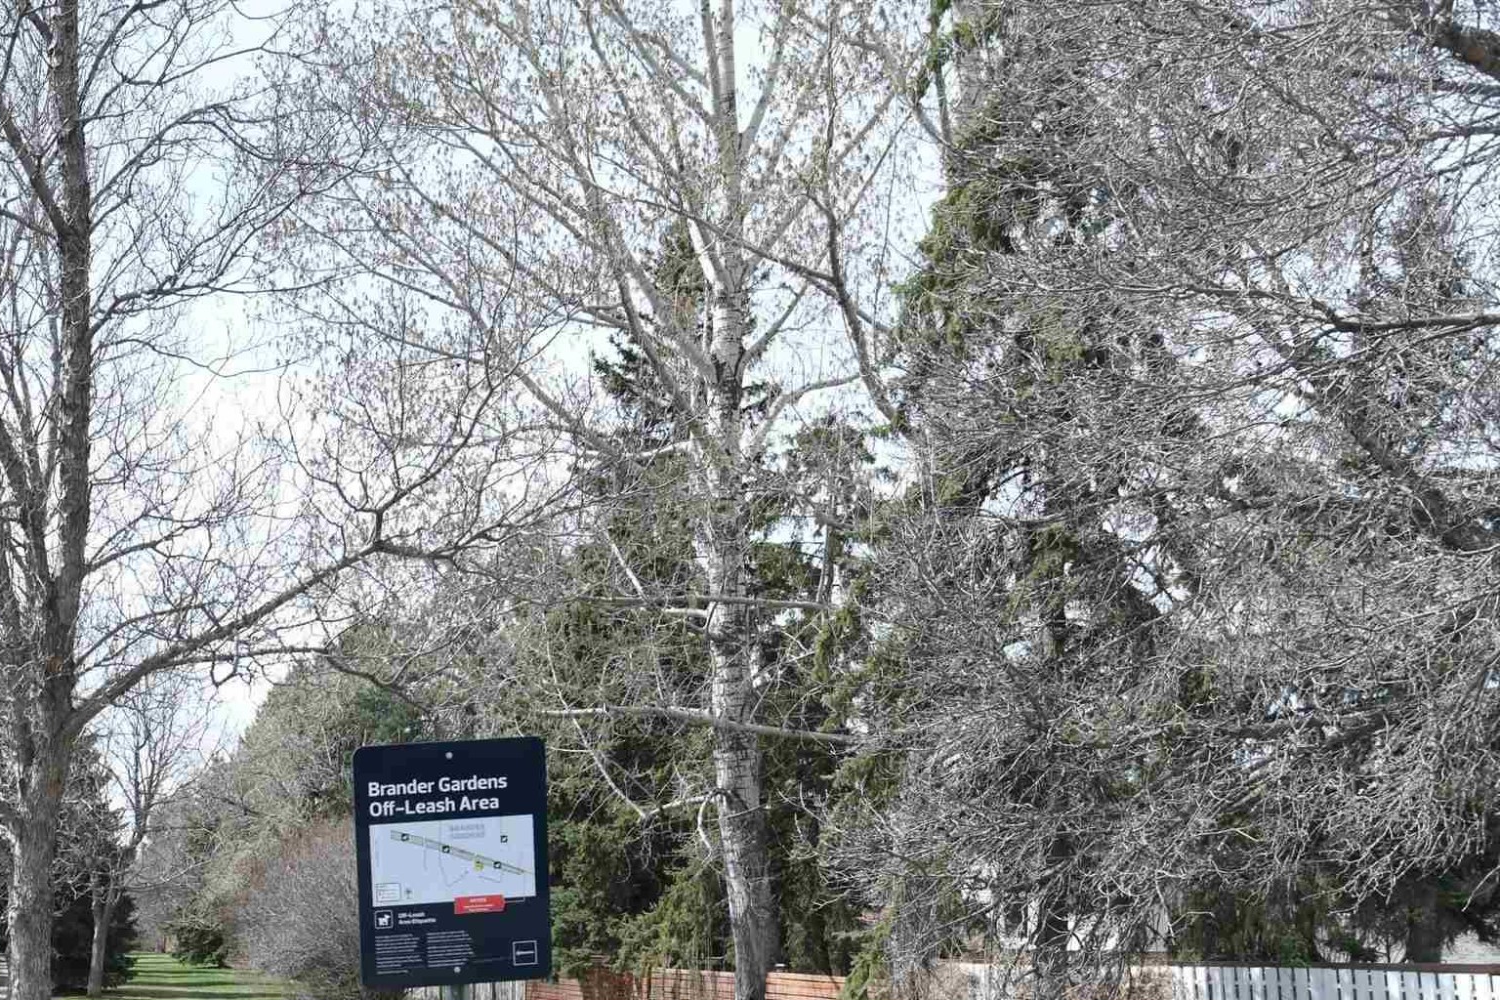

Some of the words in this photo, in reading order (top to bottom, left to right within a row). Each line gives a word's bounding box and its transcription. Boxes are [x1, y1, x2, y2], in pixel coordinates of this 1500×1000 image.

[368, 779, 435, 797] Brander
[438, 775, 508, 793] Gardens
[369, 798, 456, 817] Off-Leash
[459, 796, 500, 812] Area
